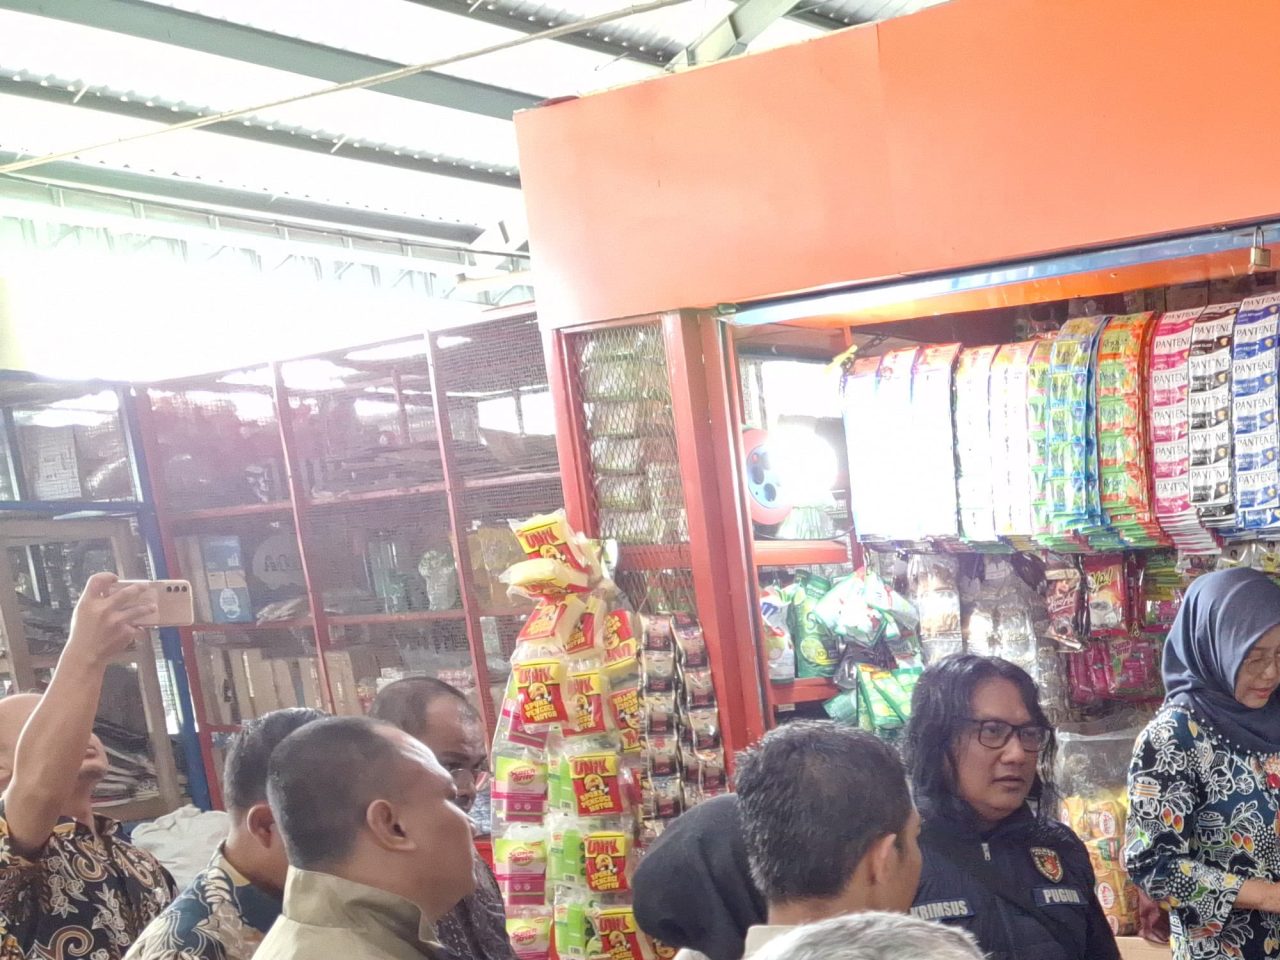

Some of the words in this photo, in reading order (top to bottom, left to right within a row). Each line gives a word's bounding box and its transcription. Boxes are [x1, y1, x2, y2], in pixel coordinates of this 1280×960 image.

[1236, 324, 1274, 337] PANTENE
[1235, 360, 1273, 374] PANTENE
[1235, 397, 1273, 410] PANTENE
[1154, 409, 1187, 420] PANTEN
[1238, 434, 1274, 447] PANTENE
[1155, 446, 1188, 457] PANTEN
[1157, 481, 1189, 493] PANTEN
[910, 900, 968, 921] KRIMSUS
